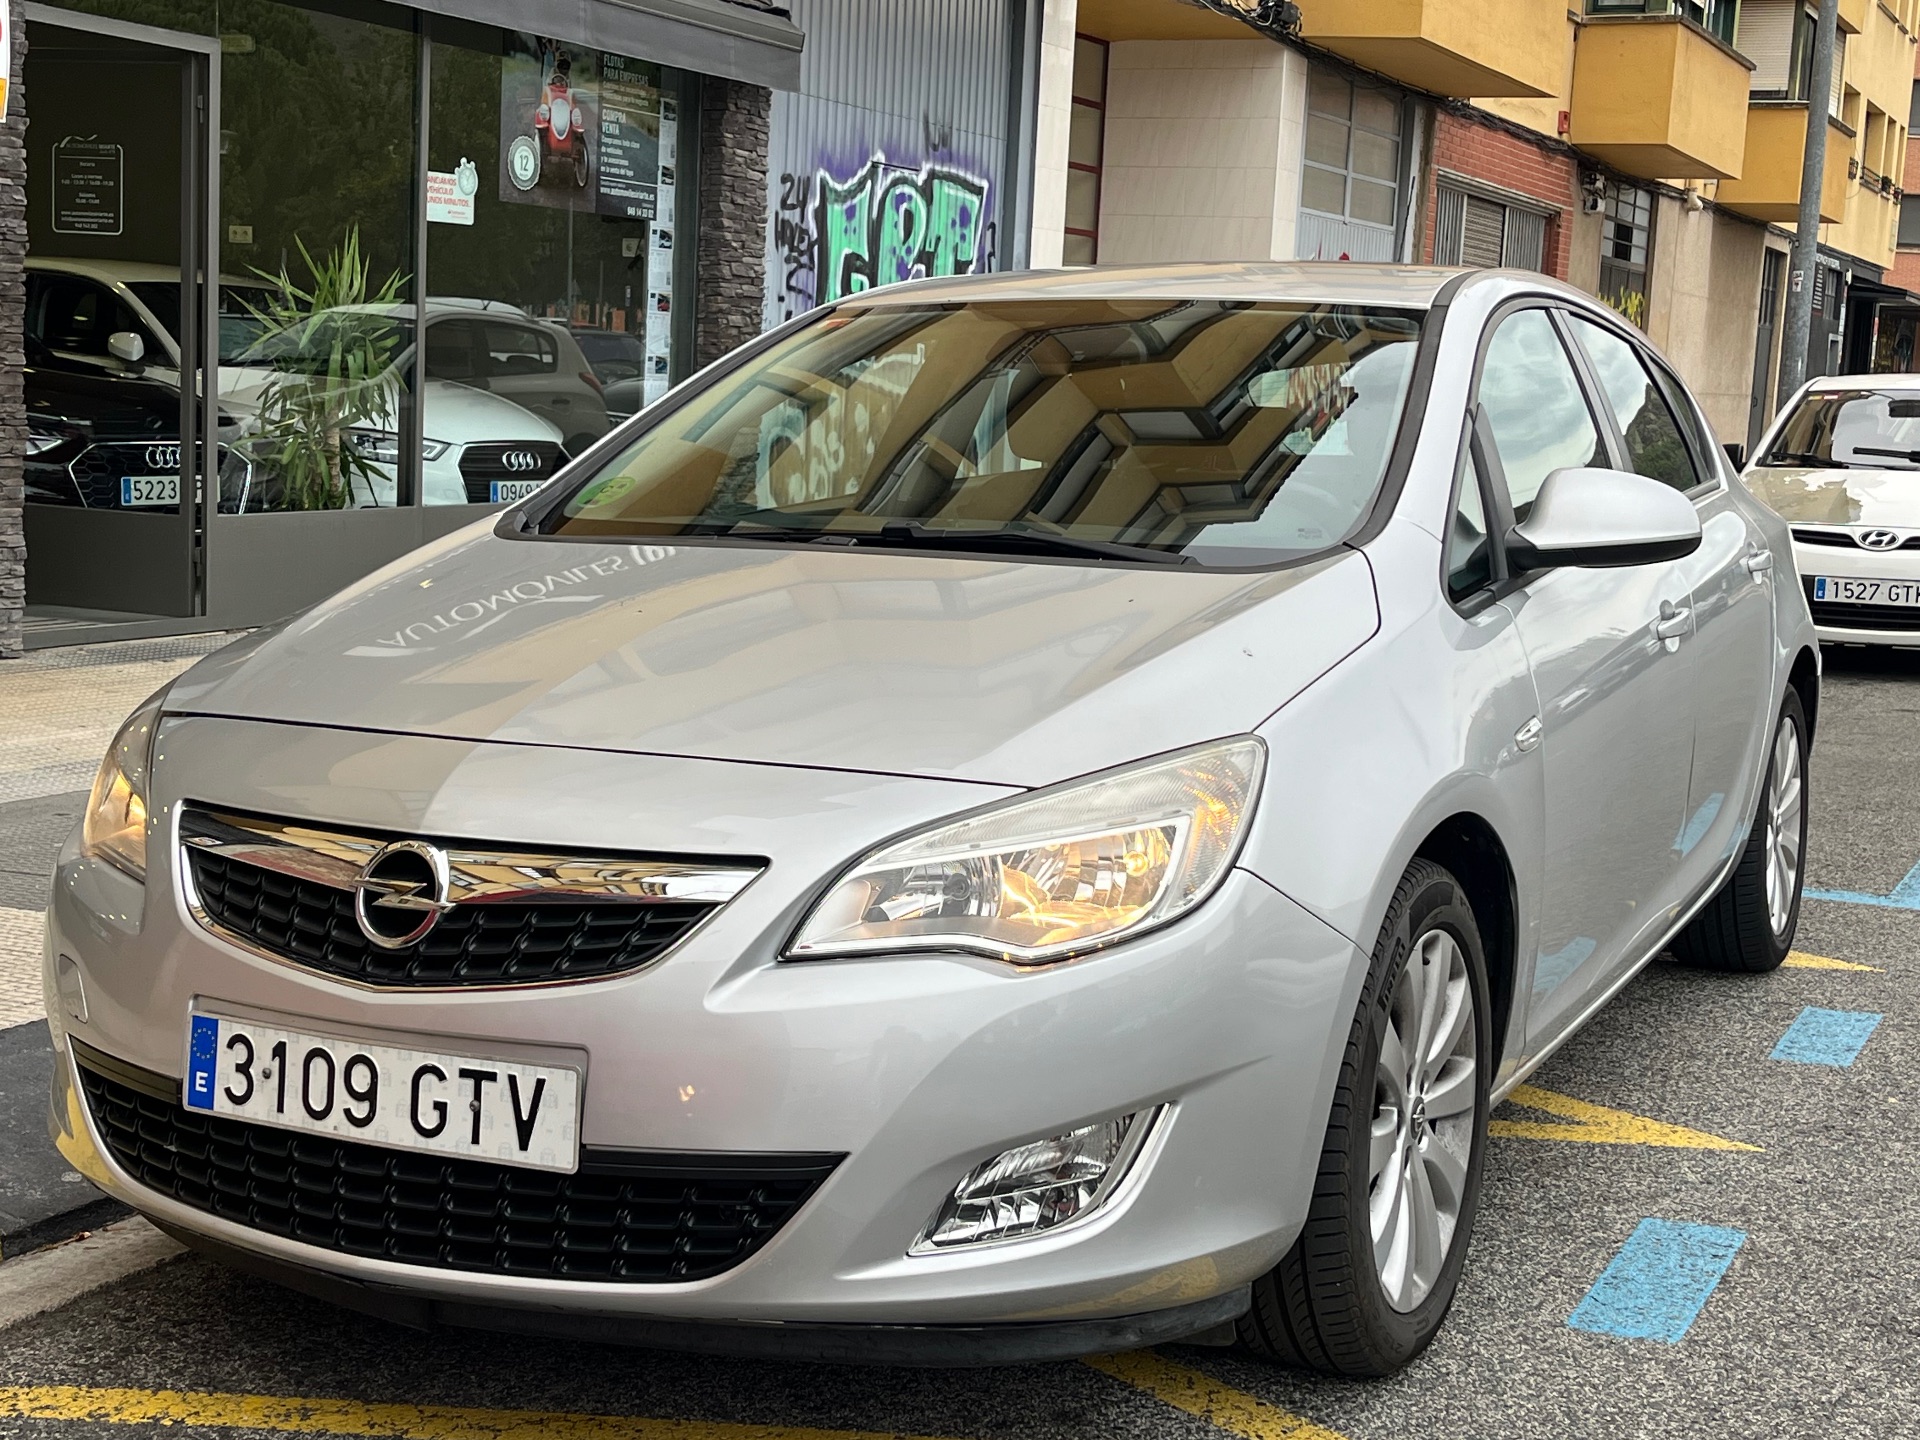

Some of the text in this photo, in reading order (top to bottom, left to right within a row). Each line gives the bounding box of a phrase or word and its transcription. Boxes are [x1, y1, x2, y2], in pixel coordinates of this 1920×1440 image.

[602, 121, 620, 135] VENTA
[520, 154, 529, 172] 12
[133, 480, 177, 500] 5223
[1833, 581, 1881, 601] 1527
[194, 1032, 547, 1152] E 3109 GTV
